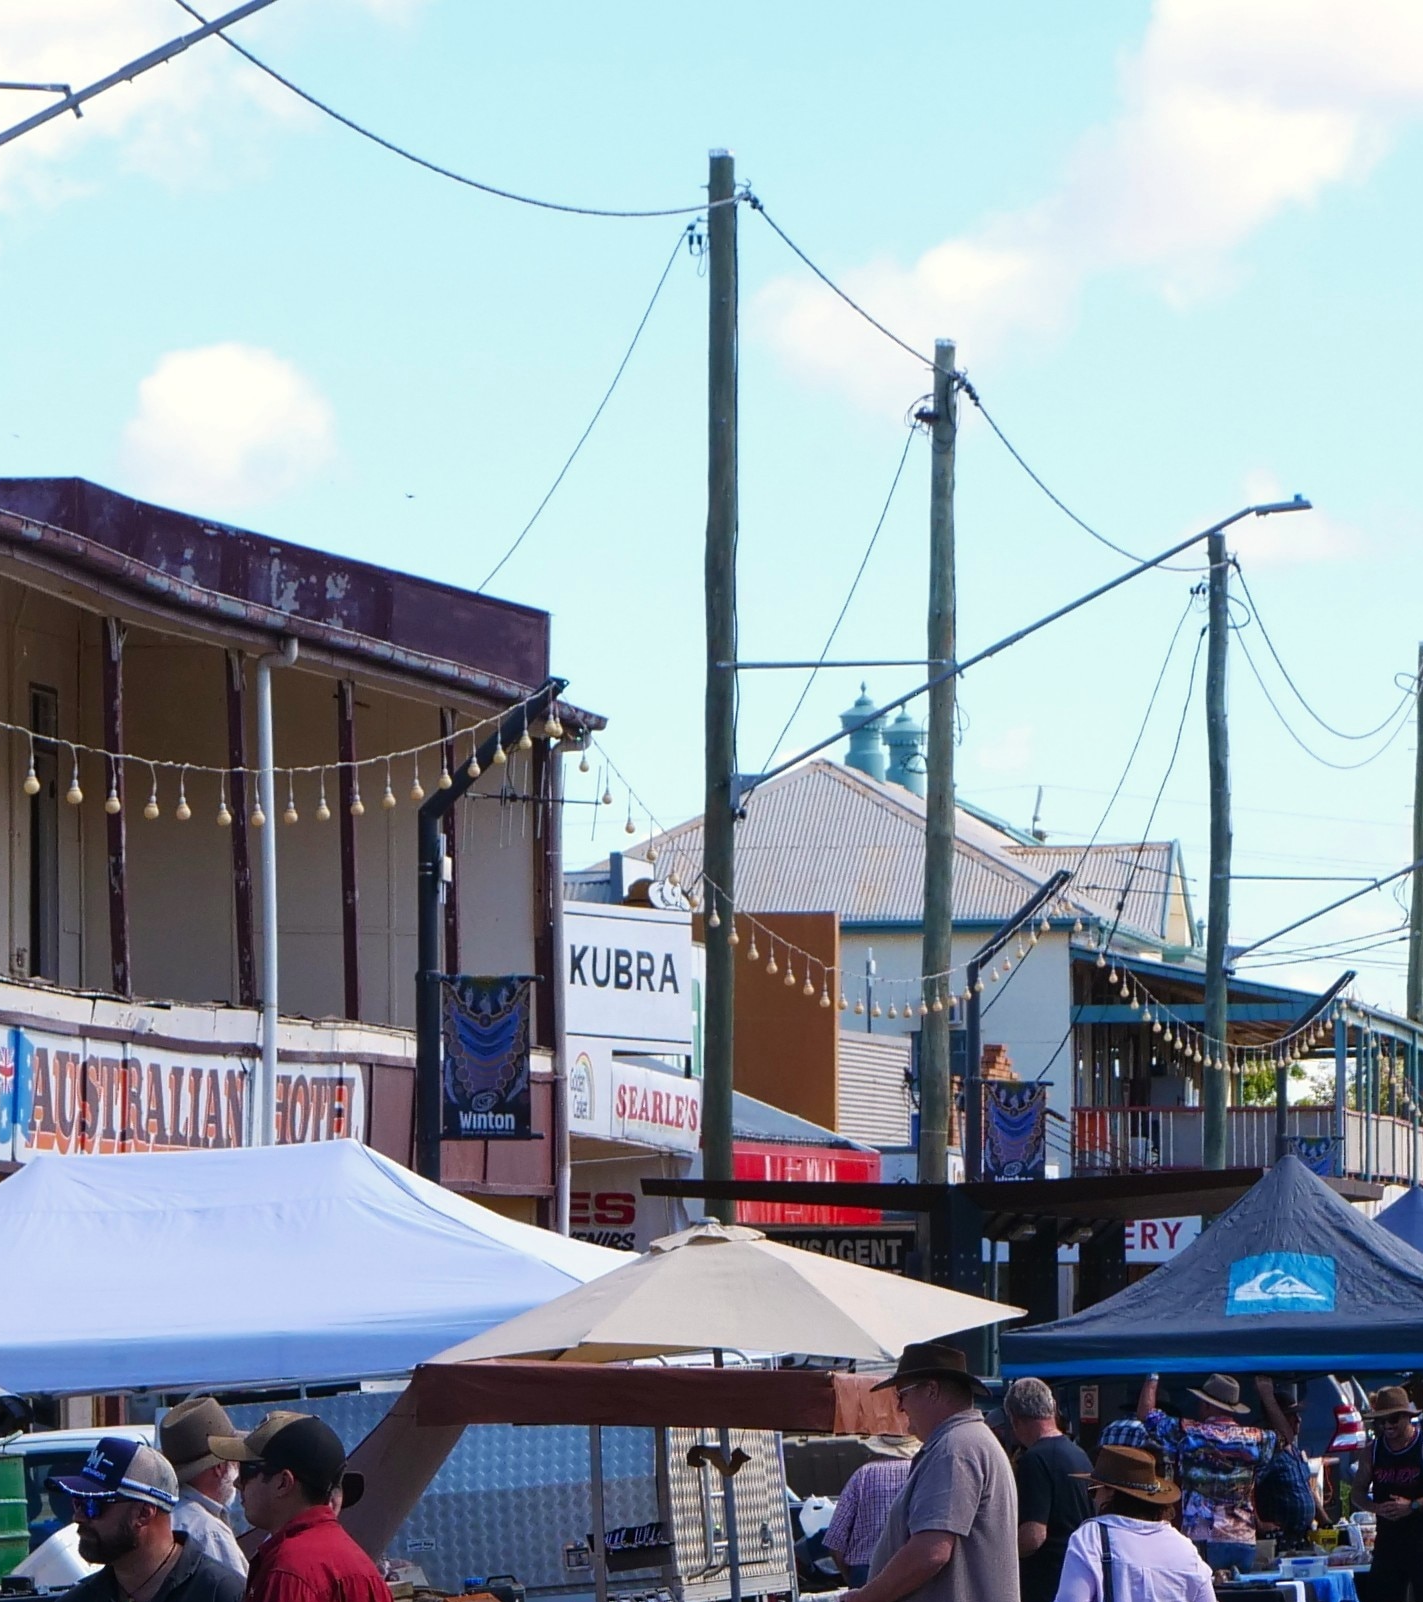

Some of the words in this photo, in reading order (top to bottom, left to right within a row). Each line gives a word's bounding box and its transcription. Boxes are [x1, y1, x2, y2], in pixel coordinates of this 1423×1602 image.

[569, 944, 679, 993] KUBRA
[26, 1047, 246, 1154] AUSTRALIAN
[459, 1111, 515, 1130] Winton
[615, 1083, 698, 1132] SEARLE'S
[1125, 1220, 1183, 1250] ERY
